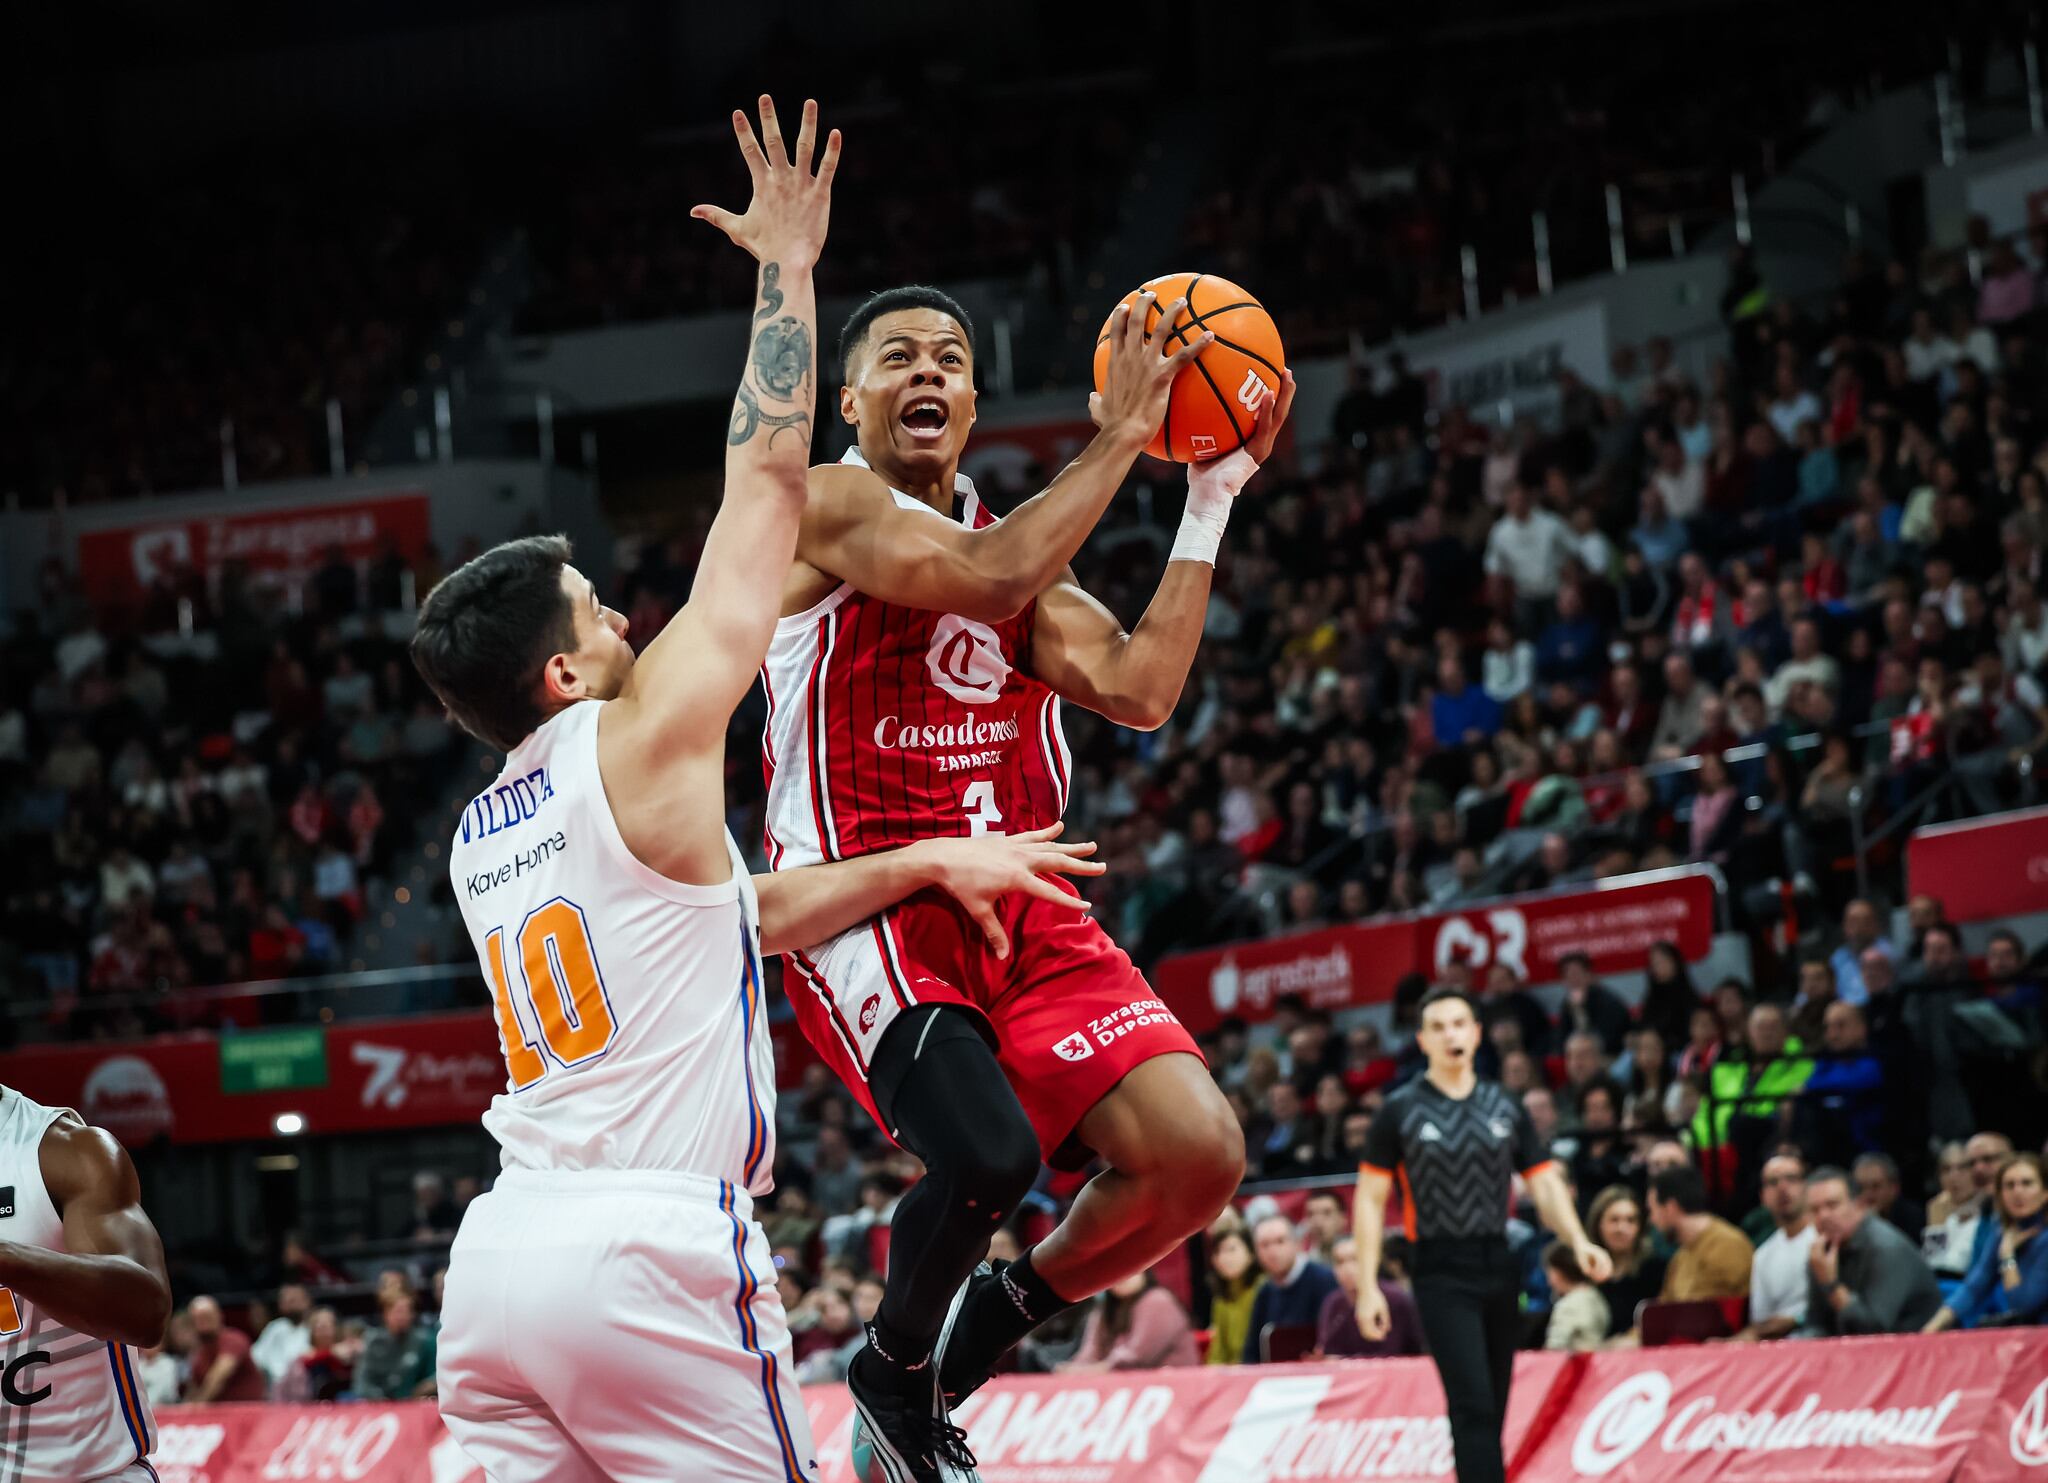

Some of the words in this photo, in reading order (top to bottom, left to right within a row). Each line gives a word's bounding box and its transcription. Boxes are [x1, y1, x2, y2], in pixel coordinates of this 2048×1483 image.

[462, 768, 554, 844] VILDOZA
[467, 865, 511, 900] Kave
[515, 832, 566, 877] Home
[485, 896, 618, 1094] 10
[967, 1385, 1175, 1463] AMBAR
[1661, 1389, 1964, 1454] Casademont
